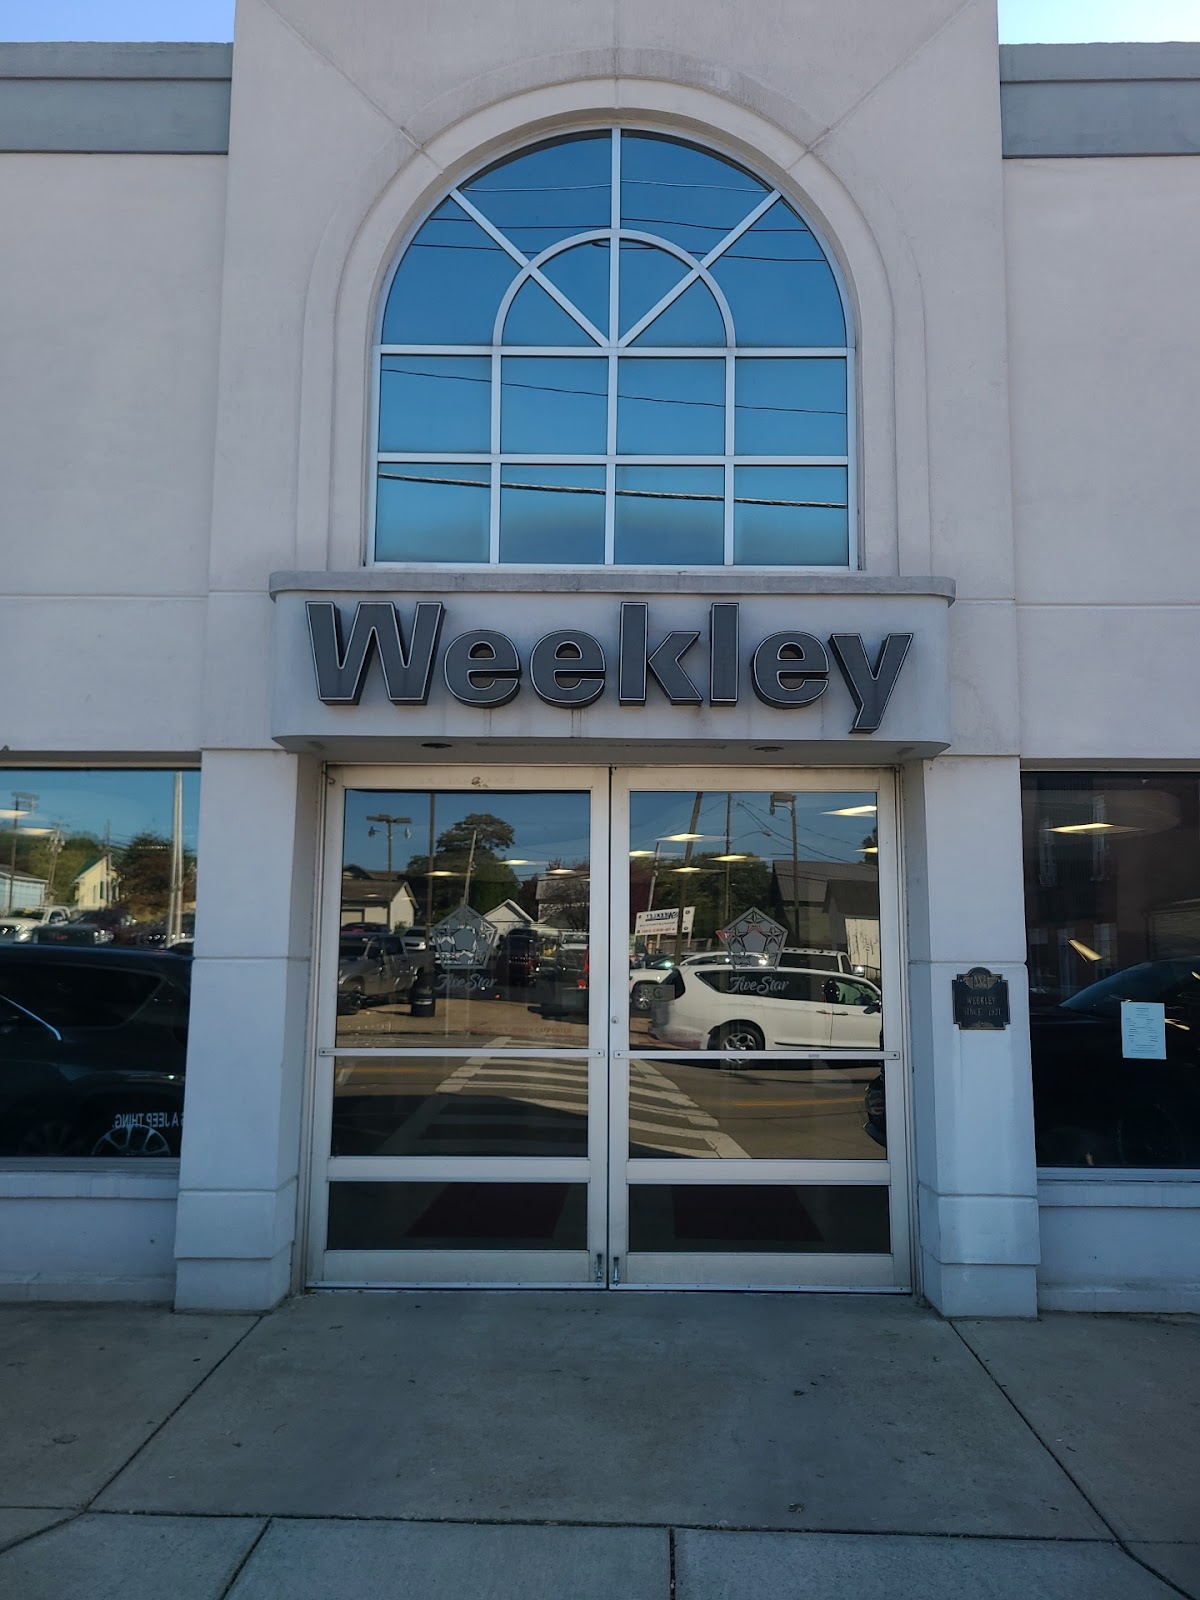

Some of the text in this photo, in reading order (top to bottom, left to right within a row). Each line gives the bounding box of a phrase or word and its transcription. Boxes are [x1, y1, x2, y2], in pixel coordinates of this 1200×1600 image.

[306, 601, 914, 734] Weekley
[465, 973, 498, 990] Star
[726, 976, 790, 994] Five Star
[966, 996, 996, 1005] WEEKLEY
